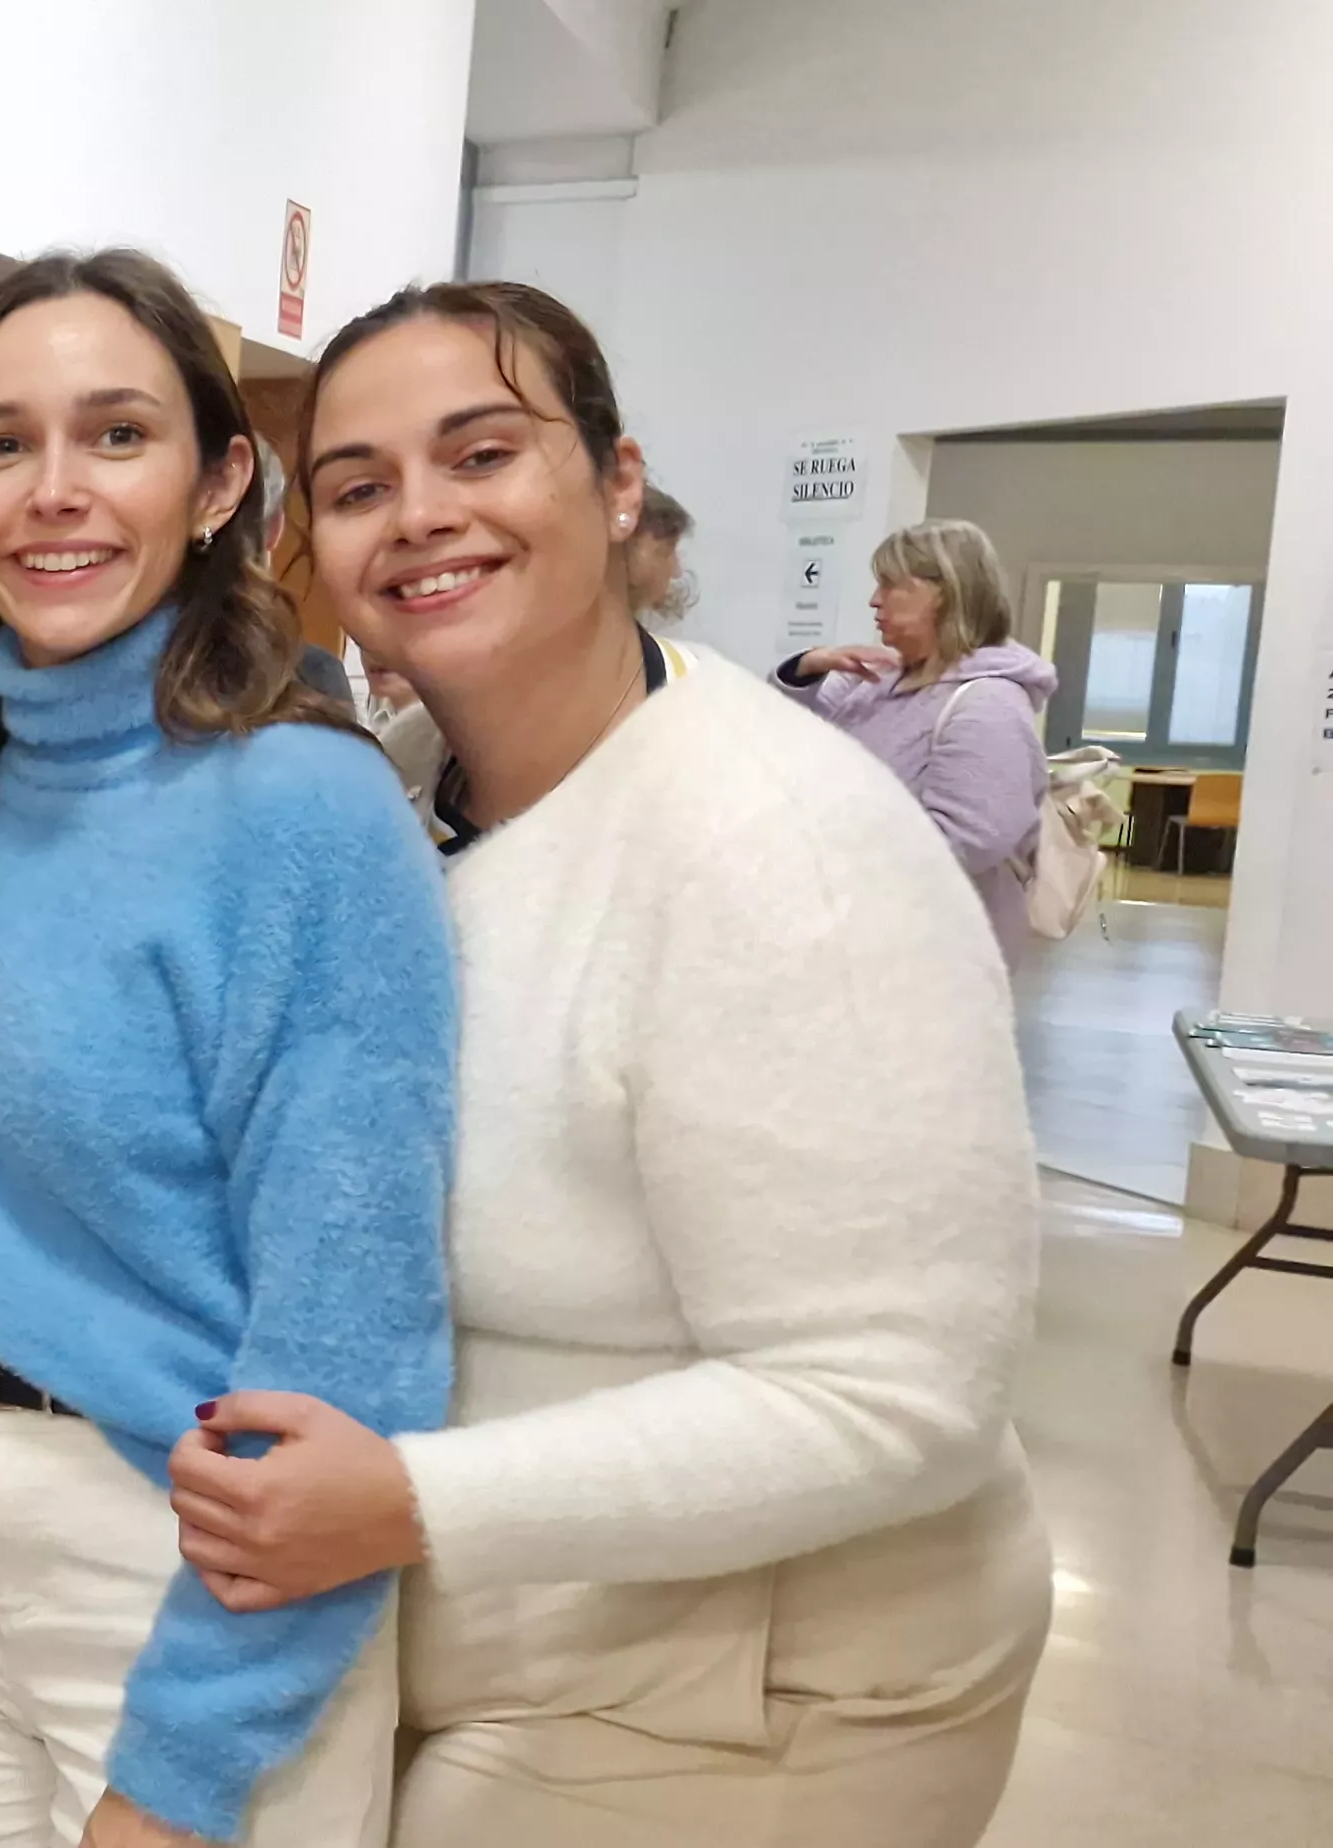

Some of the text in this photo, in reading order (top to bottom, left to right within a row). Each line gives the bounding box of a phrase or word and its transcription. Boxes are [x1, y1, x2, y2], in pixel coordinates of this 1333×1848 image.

[793, 458, 856, 475] SE RUEGA
[792, 480, 855, 501] SILENCIO
